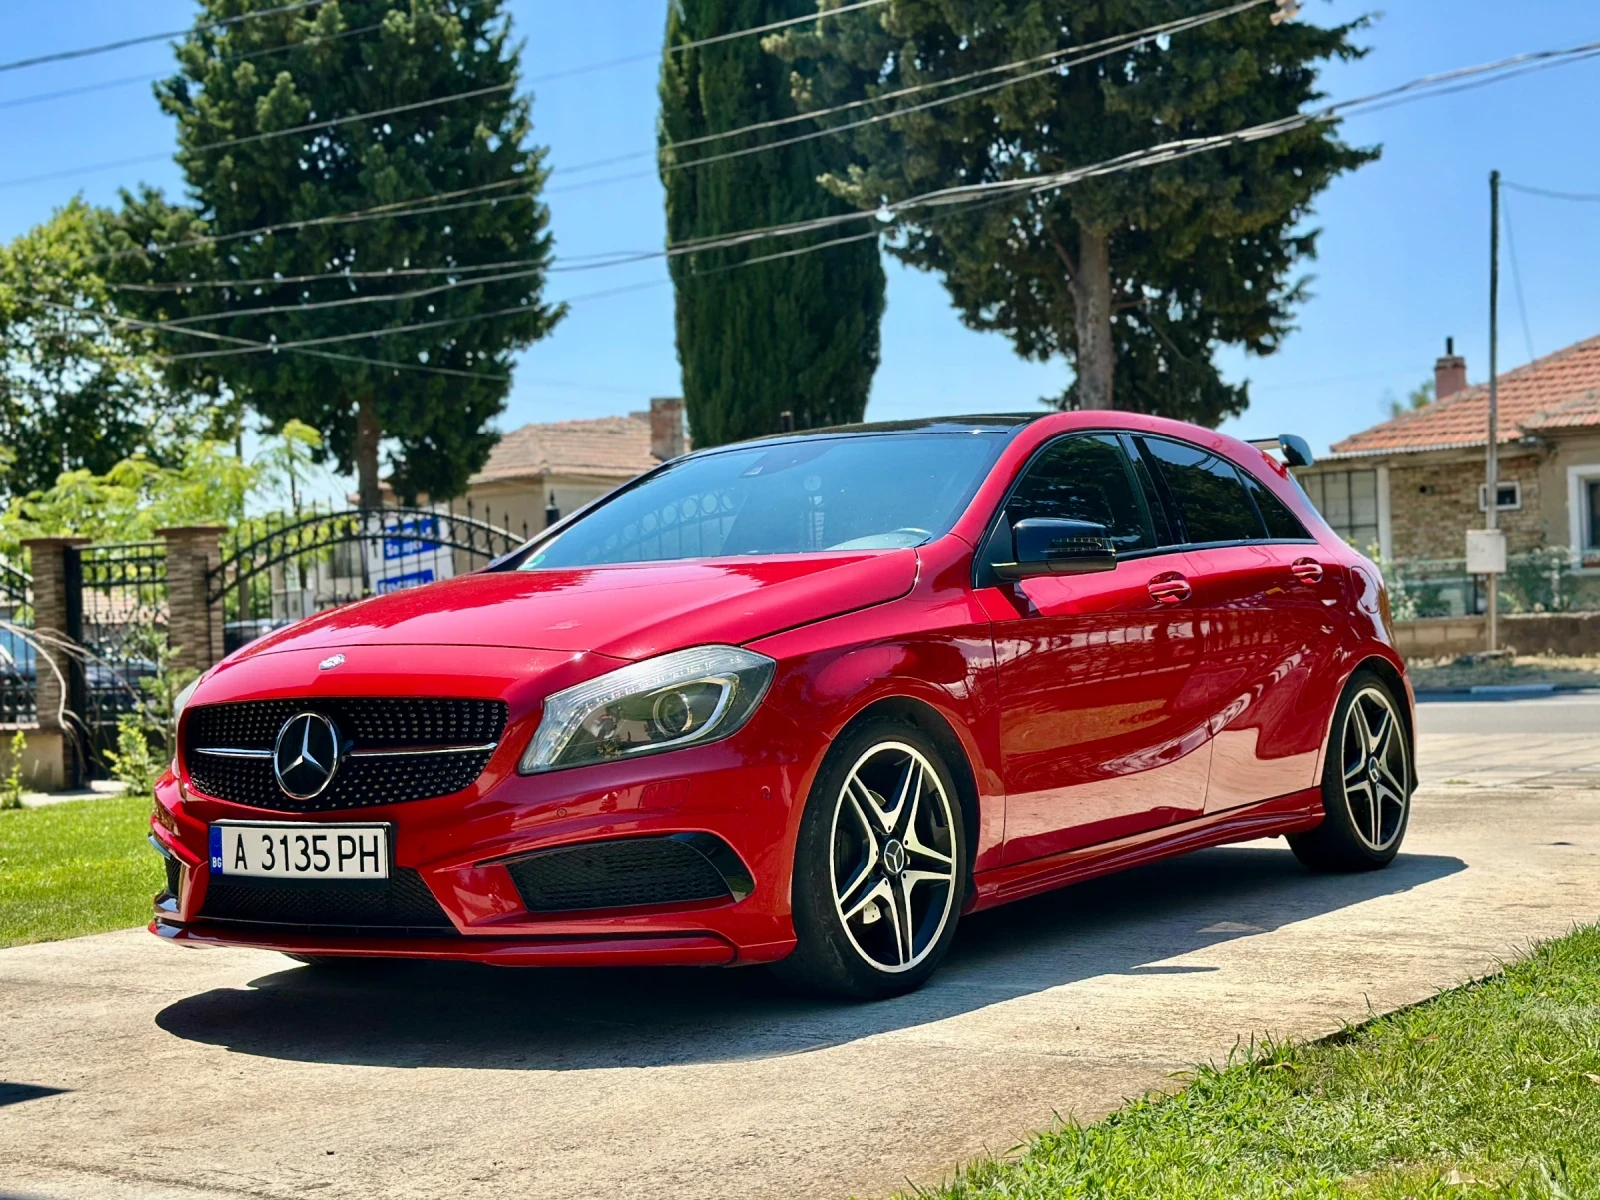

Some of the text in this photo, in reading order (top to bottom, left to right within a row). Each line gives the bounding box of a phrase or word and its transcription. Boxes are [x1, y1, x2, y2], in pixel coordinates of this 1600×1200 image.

[212, 856, 222, 868] BG
[235, 833, 379, 872] A 3135 PH
